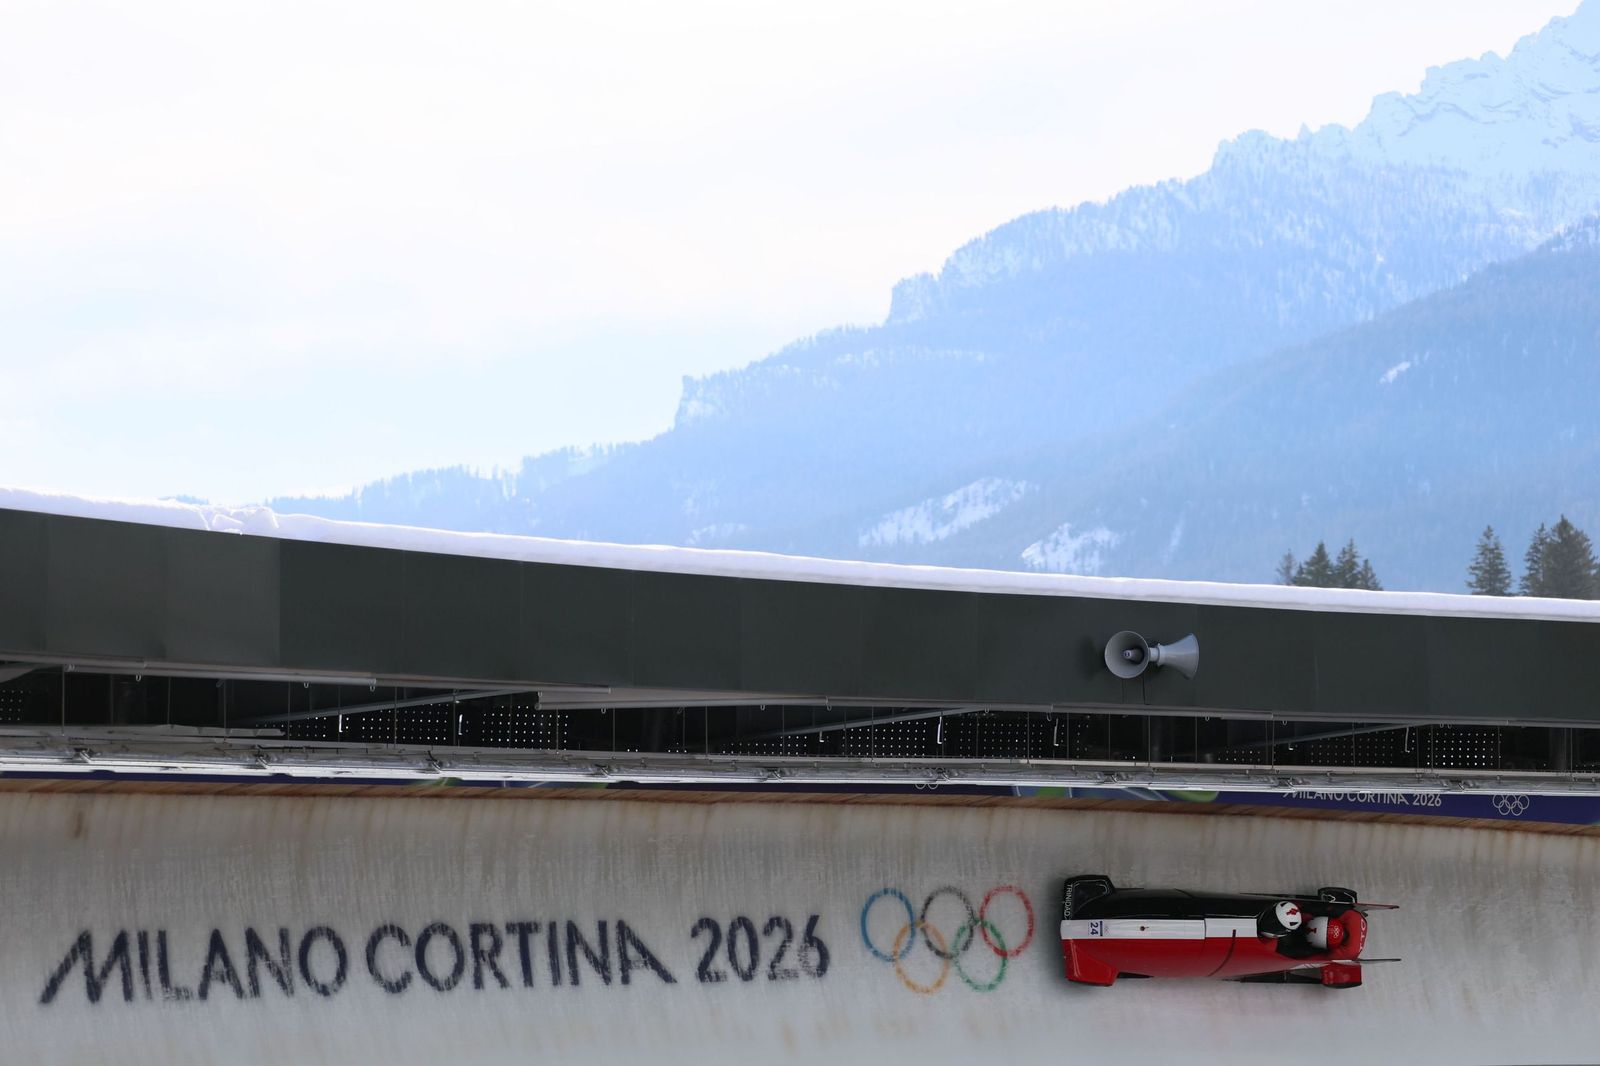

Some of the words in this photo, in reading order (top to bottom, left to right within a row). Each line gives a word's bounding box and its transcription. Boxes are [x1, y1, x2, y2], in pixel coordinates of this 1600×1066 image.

[1347, 792, 1409, 805] CORTINA
[1413, 793, 1442, 807] 2026
[1064, 884, 1072, 917] TRINIDAD
[1090, 922, 1099, 935] 24
[40, 926, 348, 1003] MILANO
[365, 919, 677, 994] CORTINA
[690, 914, 830, 983] 2026
